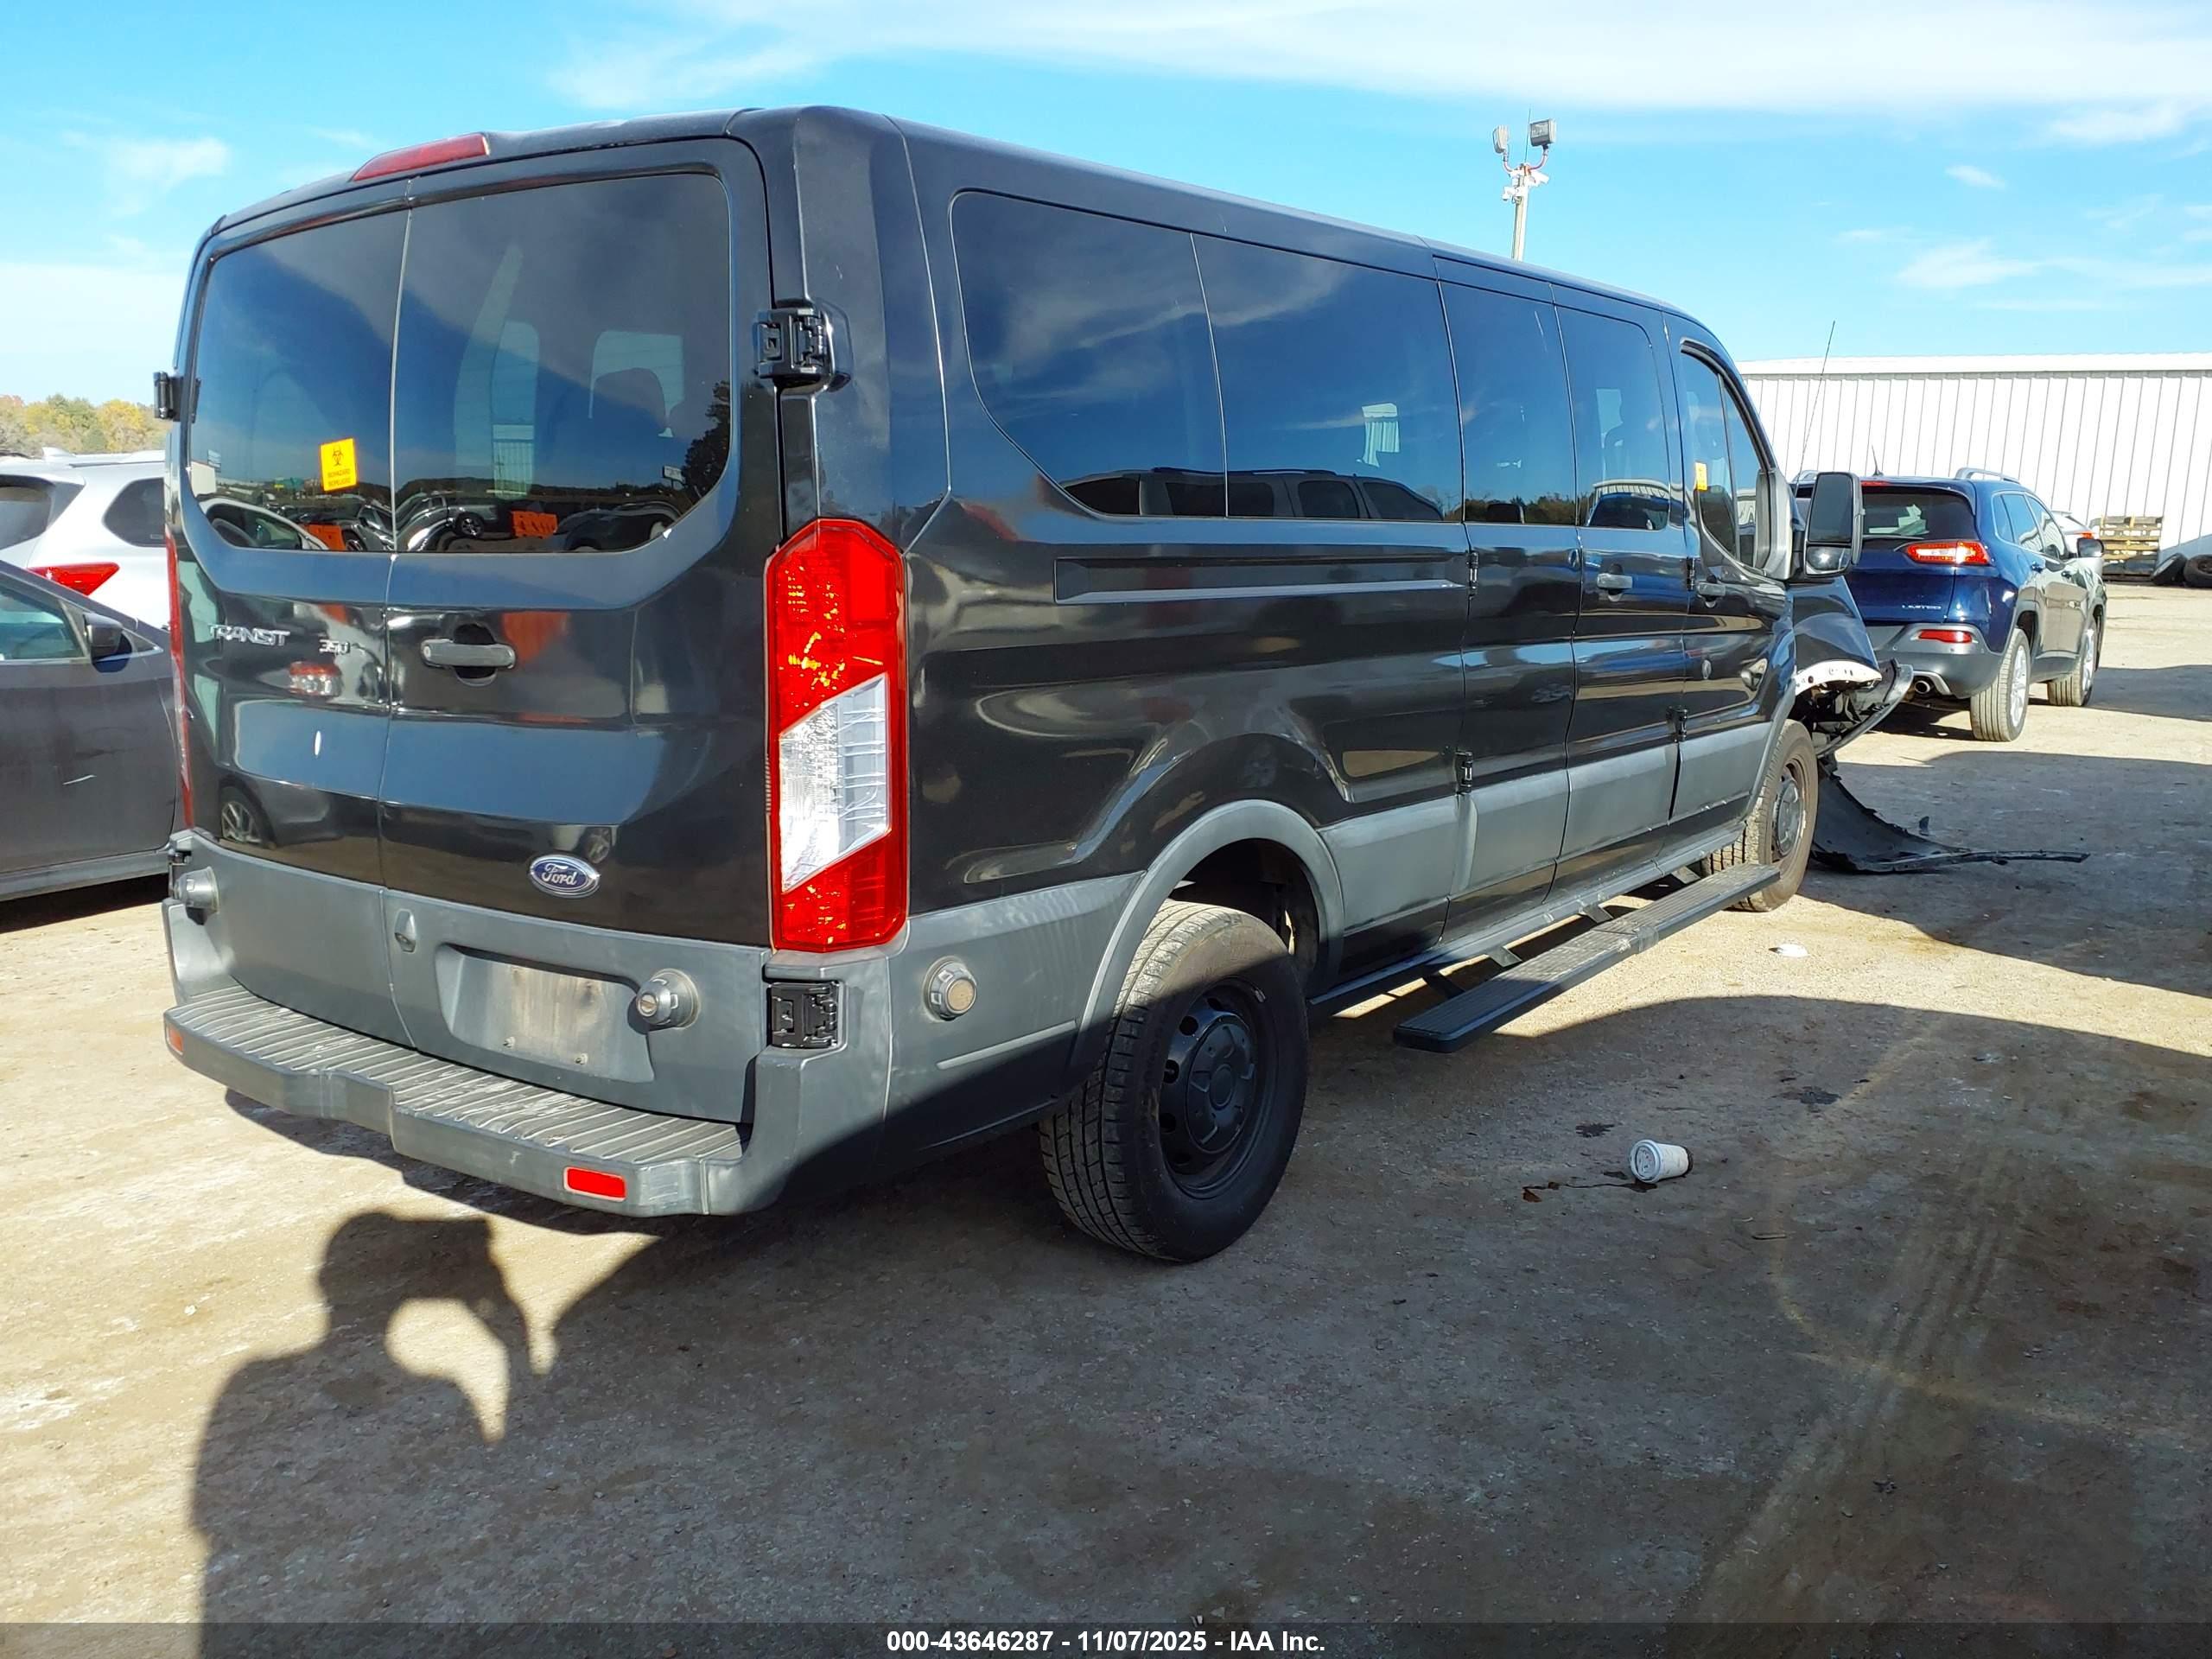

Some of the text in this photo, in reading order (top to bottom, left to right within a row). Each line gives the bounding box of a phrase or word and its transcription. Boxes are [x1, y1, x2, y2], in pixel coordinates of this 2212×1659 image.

[207, 624, 290, 646] TRANSIT
[319, 639, 349, 654] 350
[542, 862, 577, 886] Ford
